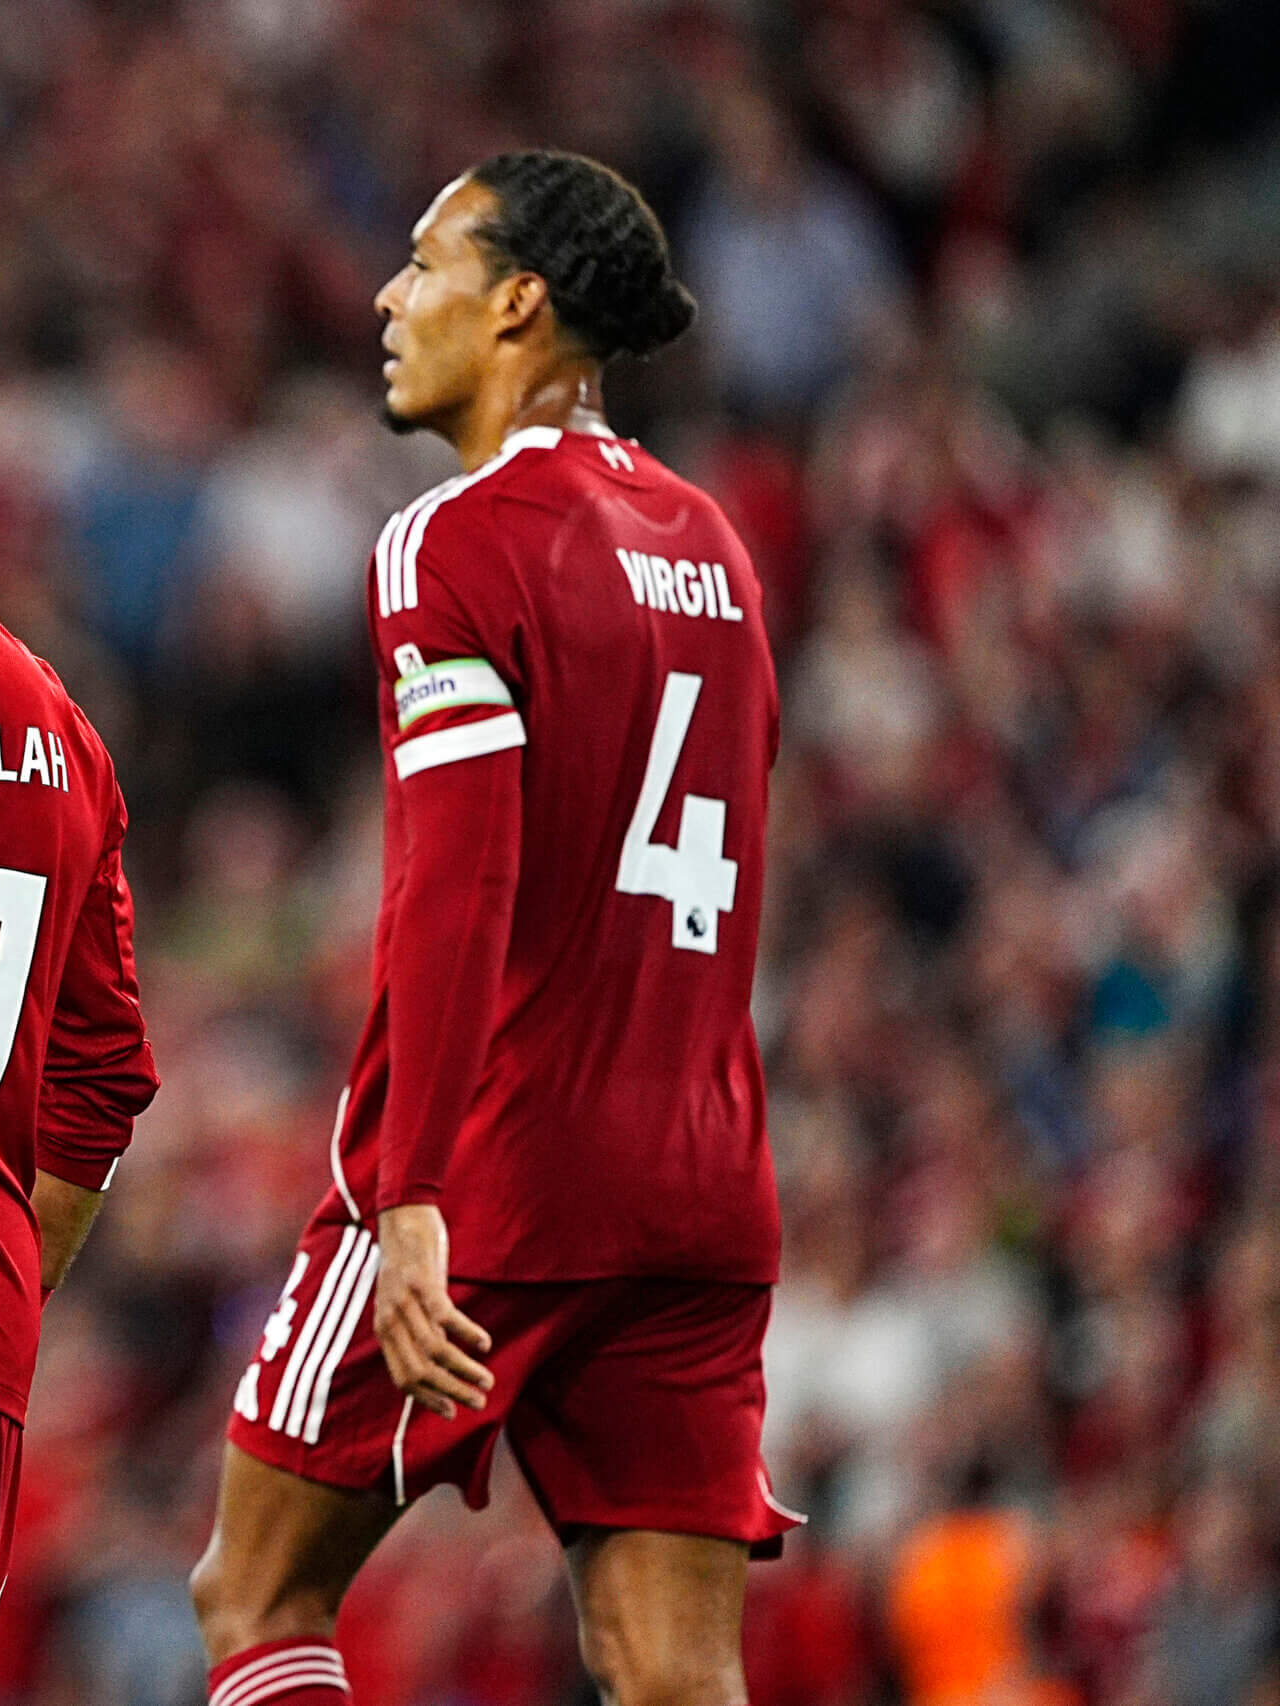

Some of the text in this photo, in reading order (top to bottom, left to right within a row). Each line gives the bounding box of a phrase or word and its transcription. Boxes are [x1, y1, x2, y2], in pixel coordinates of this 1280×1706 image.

[616, 547, 744, 622] VIRGIL
[398, 673, 456, 713] ptain
[615, 671, 739, 955] 4
